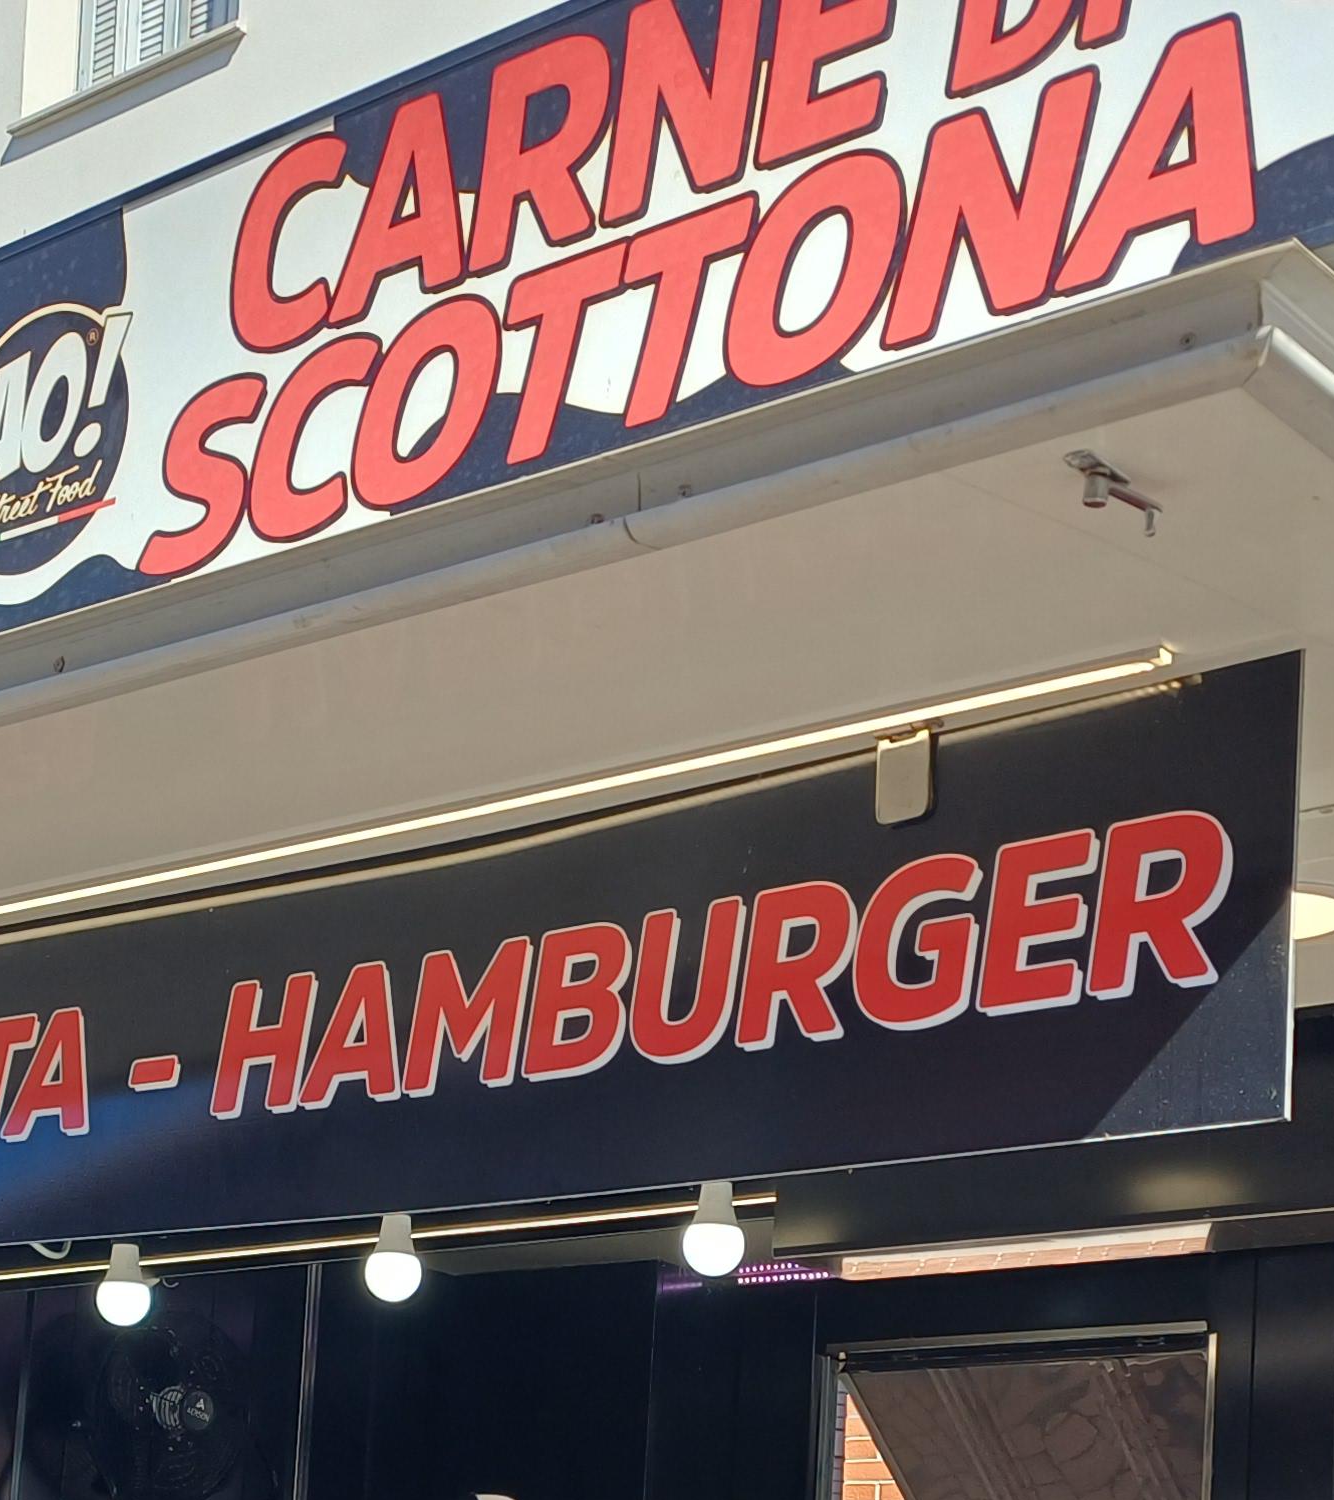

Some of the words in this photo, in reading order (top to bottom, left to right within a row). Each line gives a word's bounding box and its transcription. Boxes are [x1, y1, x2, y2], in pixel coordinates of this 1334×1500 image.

[138, 13, 1256, 582] SCOTTONA
[43, 459, 103, 512] Food
[129, 1054, 180, 1090] -
[210, 810, 1233, 1119] HAMBURGER
